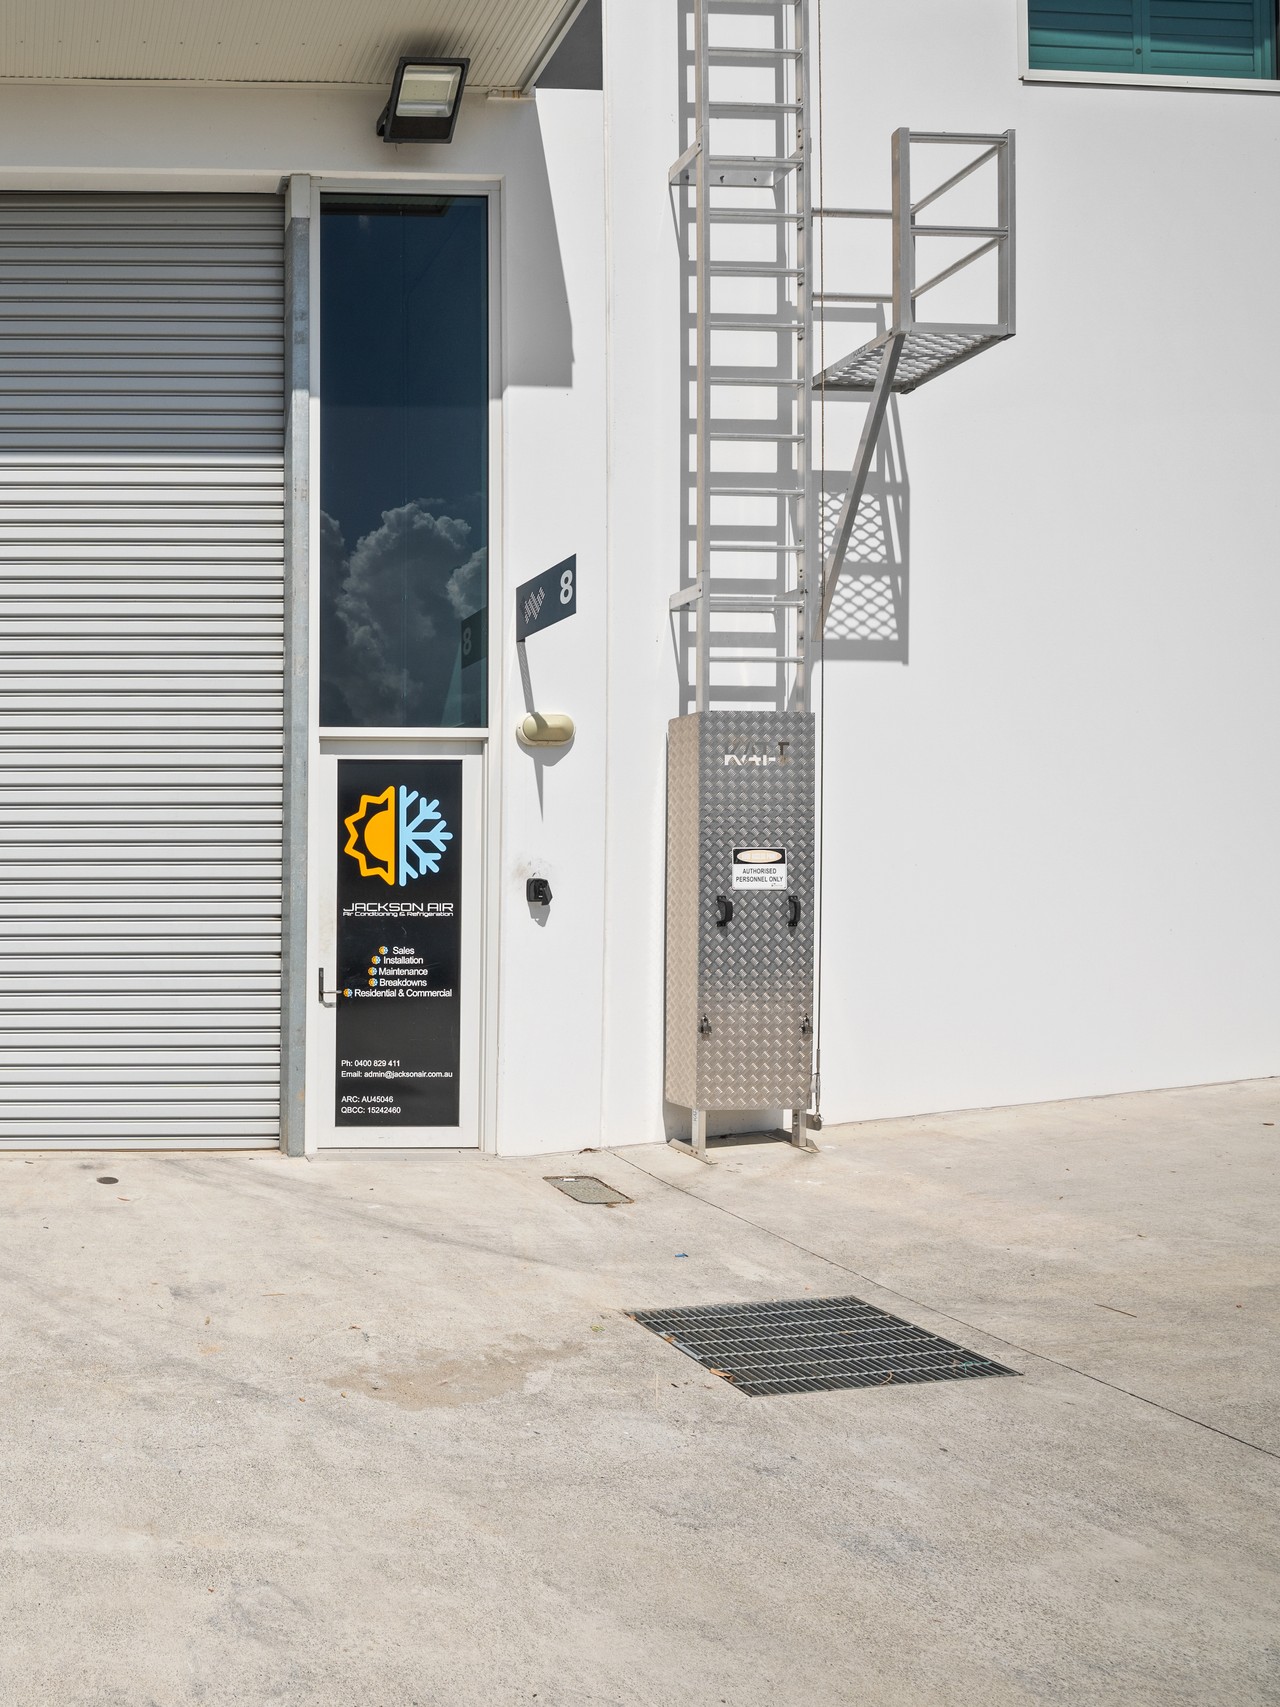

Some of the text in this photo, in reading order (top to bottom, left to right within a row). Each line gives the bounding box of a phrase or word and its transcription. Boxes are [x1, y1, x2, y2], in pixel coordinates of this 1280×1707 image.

[560, 569, 573, 605] 8
[742, 867, 777, 875] AUTHORISED
[343, 902, 454, 911] JACKSON AIR
[392, 946, 415, 955] Sales
[383, 956, 424, 965] Installation
[378, 967, 428, 976] Maintenance
[379, 978, 428, 987] Breakdowns
[354, 988, 453, 997] Residential & Commercial
[341, 1059, 400, 1067] Ph: 0400 829 411
[341, 1070, 453, 1079] Email: admin@jacksonair.com.au
[341, 1095, 394, 1103] ARC: AU45046
[340, 1106, 401, 1114] QBCC: 15242460
